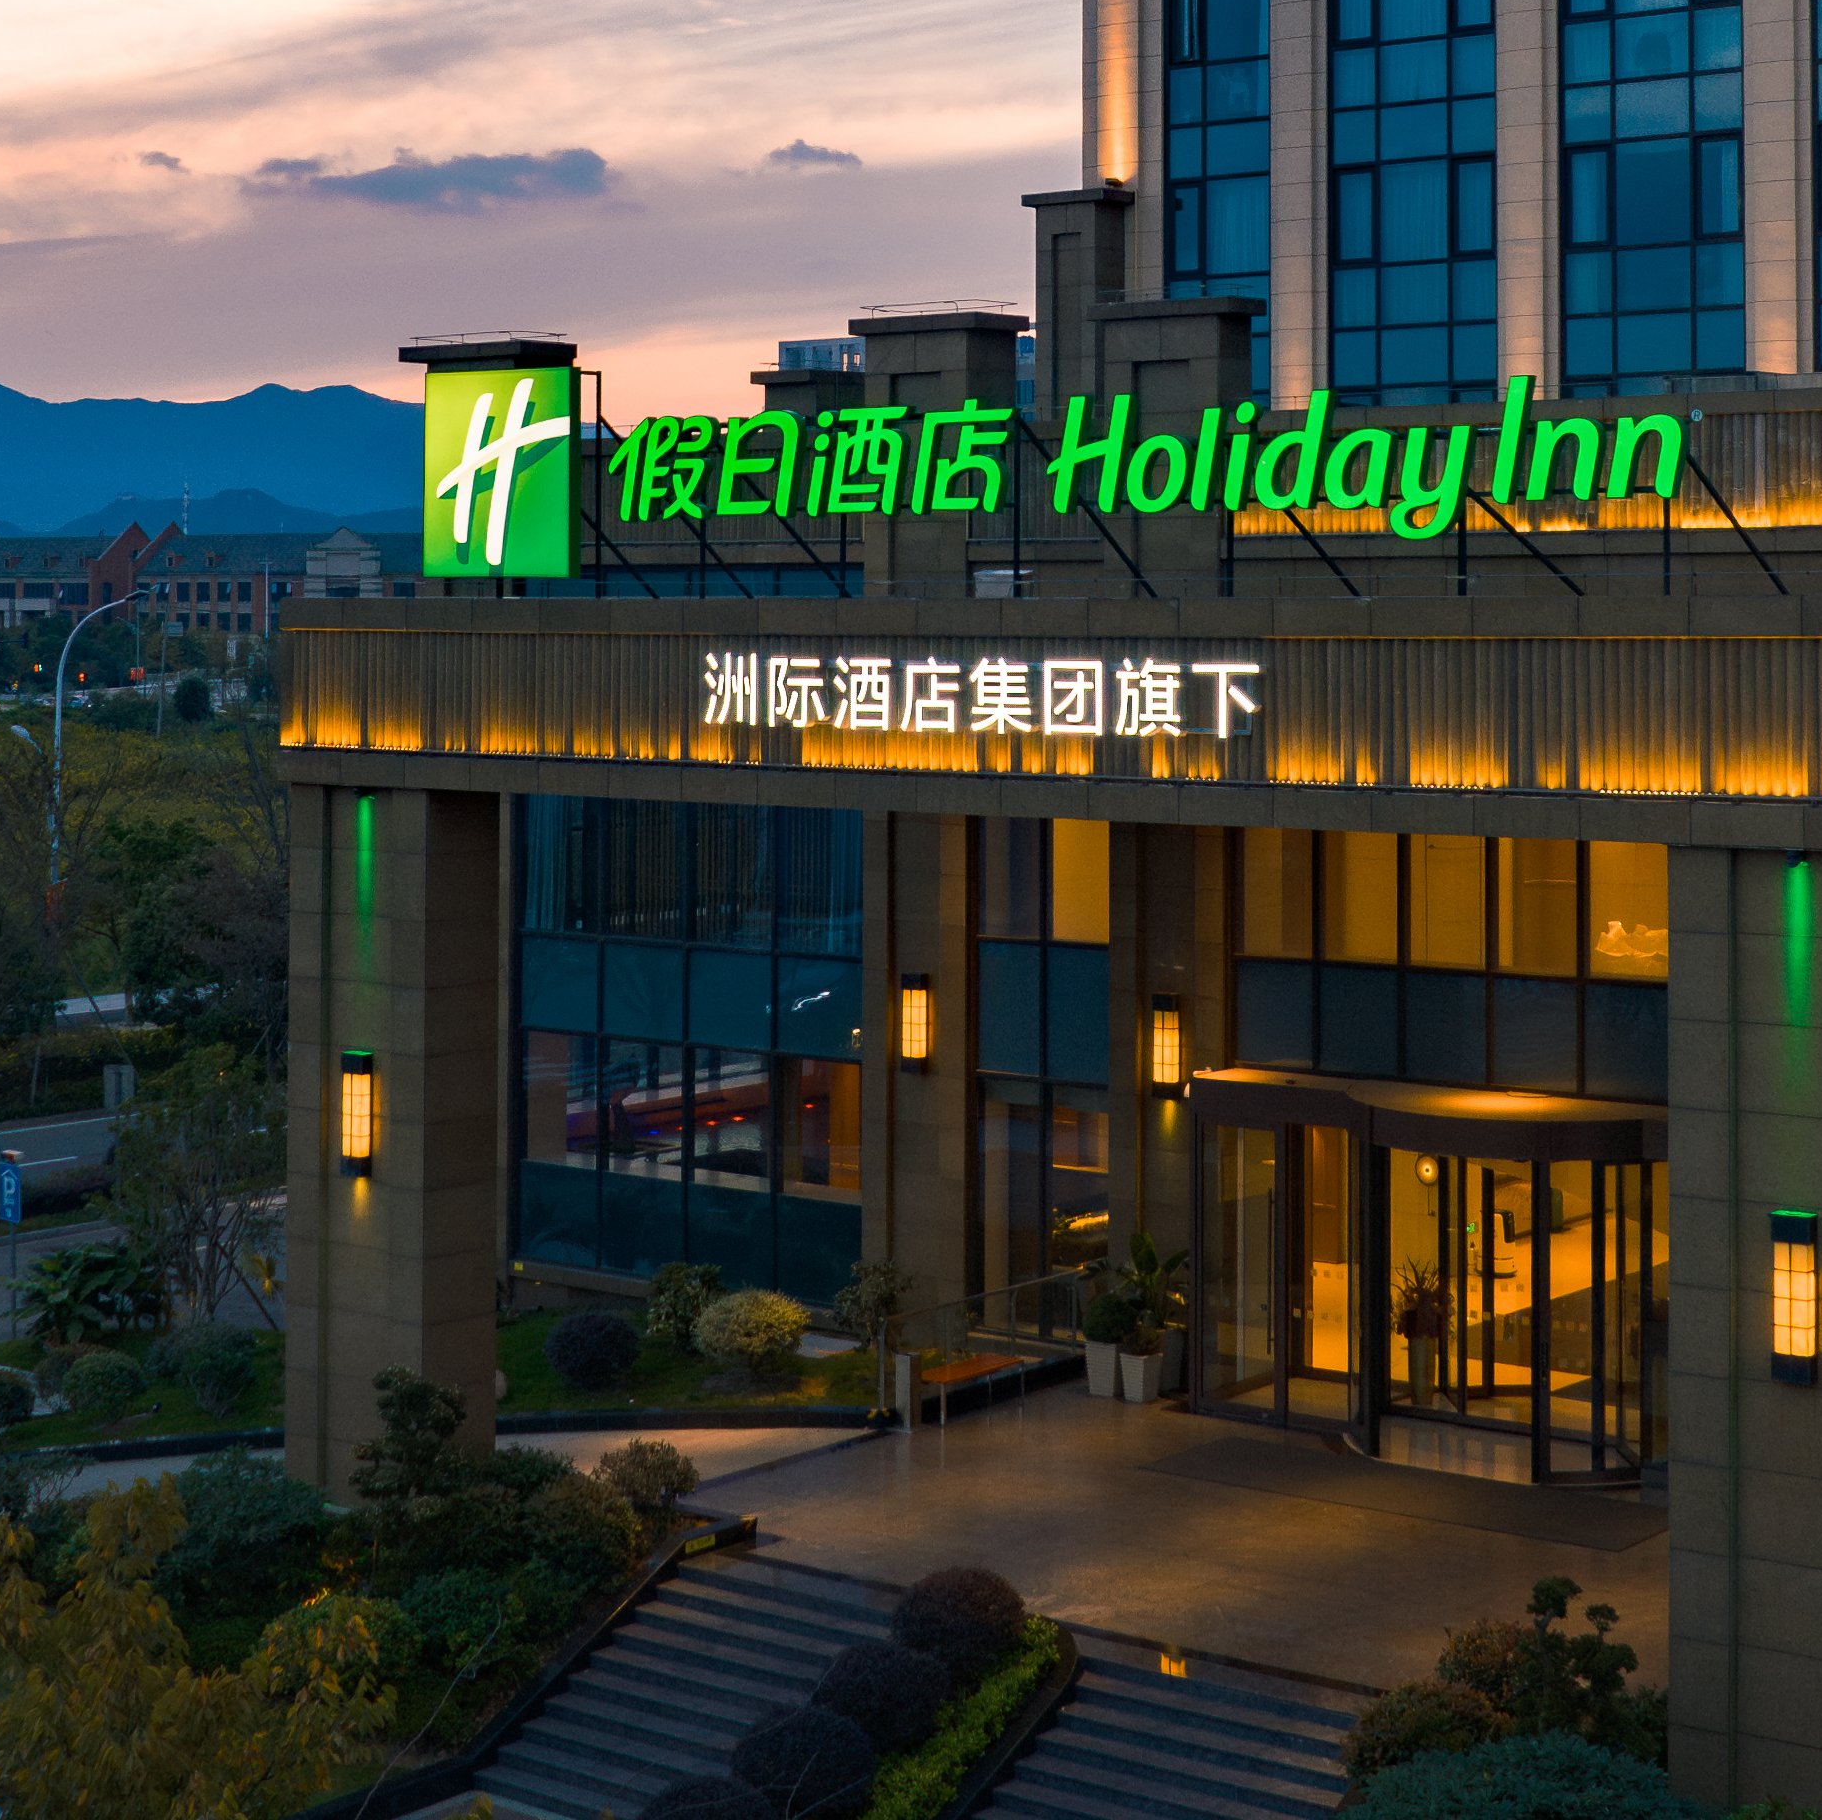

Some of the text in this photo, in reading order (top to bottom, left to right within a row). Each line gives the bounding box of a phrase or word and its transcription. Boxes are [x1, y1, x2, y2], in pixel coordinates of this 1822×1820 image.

[608, 398, 1013, 522] 假日酒店
[1046, 389, 1470, 540] Holiday
[1491, 375, 1682, 504] Inn
[703, 651, 1260, 739] 洲际酒店集团旗下
